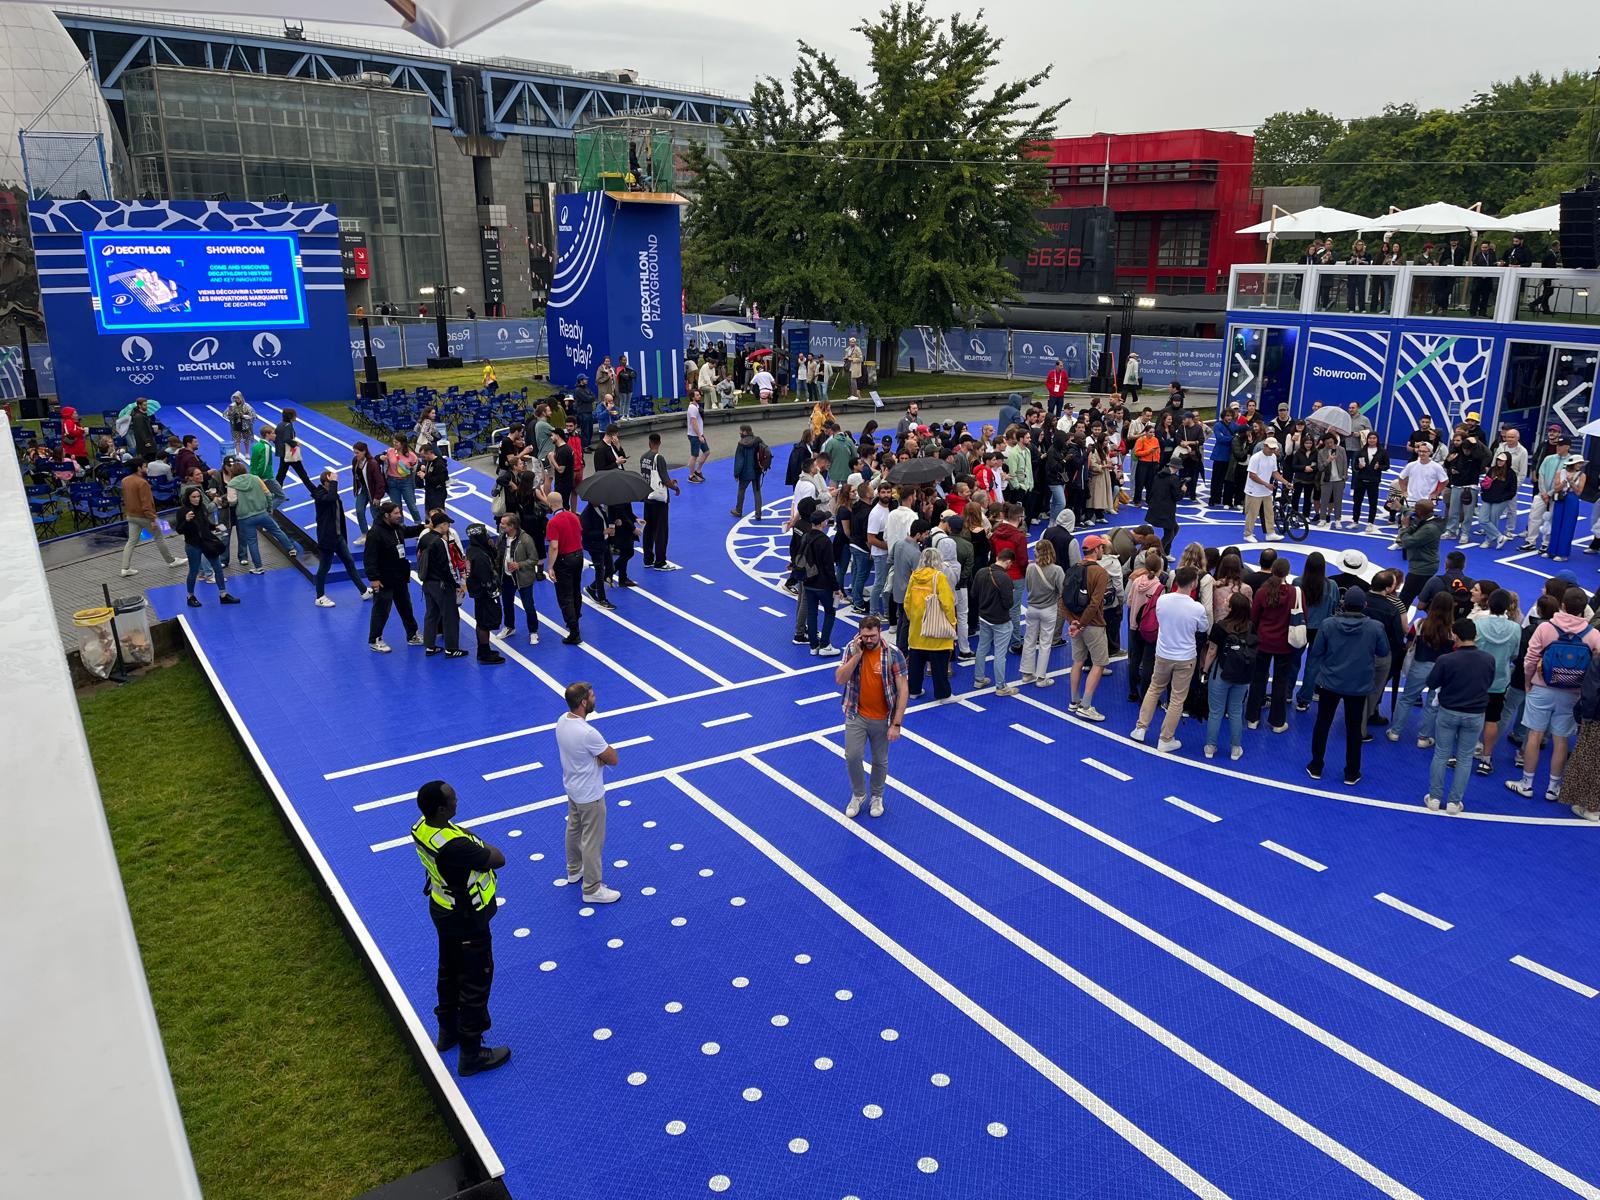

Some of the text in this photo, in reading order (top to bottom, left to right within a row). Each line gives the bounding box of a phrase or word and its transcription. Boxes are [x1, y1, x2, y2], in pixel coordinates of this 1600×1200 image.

[115, 246, 171, 255] DECATHLON
[206, 246, 265, 254] SHOWROOM
[639, 251, 651, 322] DECATHLON
[648, 234, 661, 321] PLAYGROUND
[559, 317, 583, 345] Ready
[178, 362, 235, 372] DECATHLON
[566, 344, 593, 370] to play?
[1313, 366, 1367, 381] Showroom
